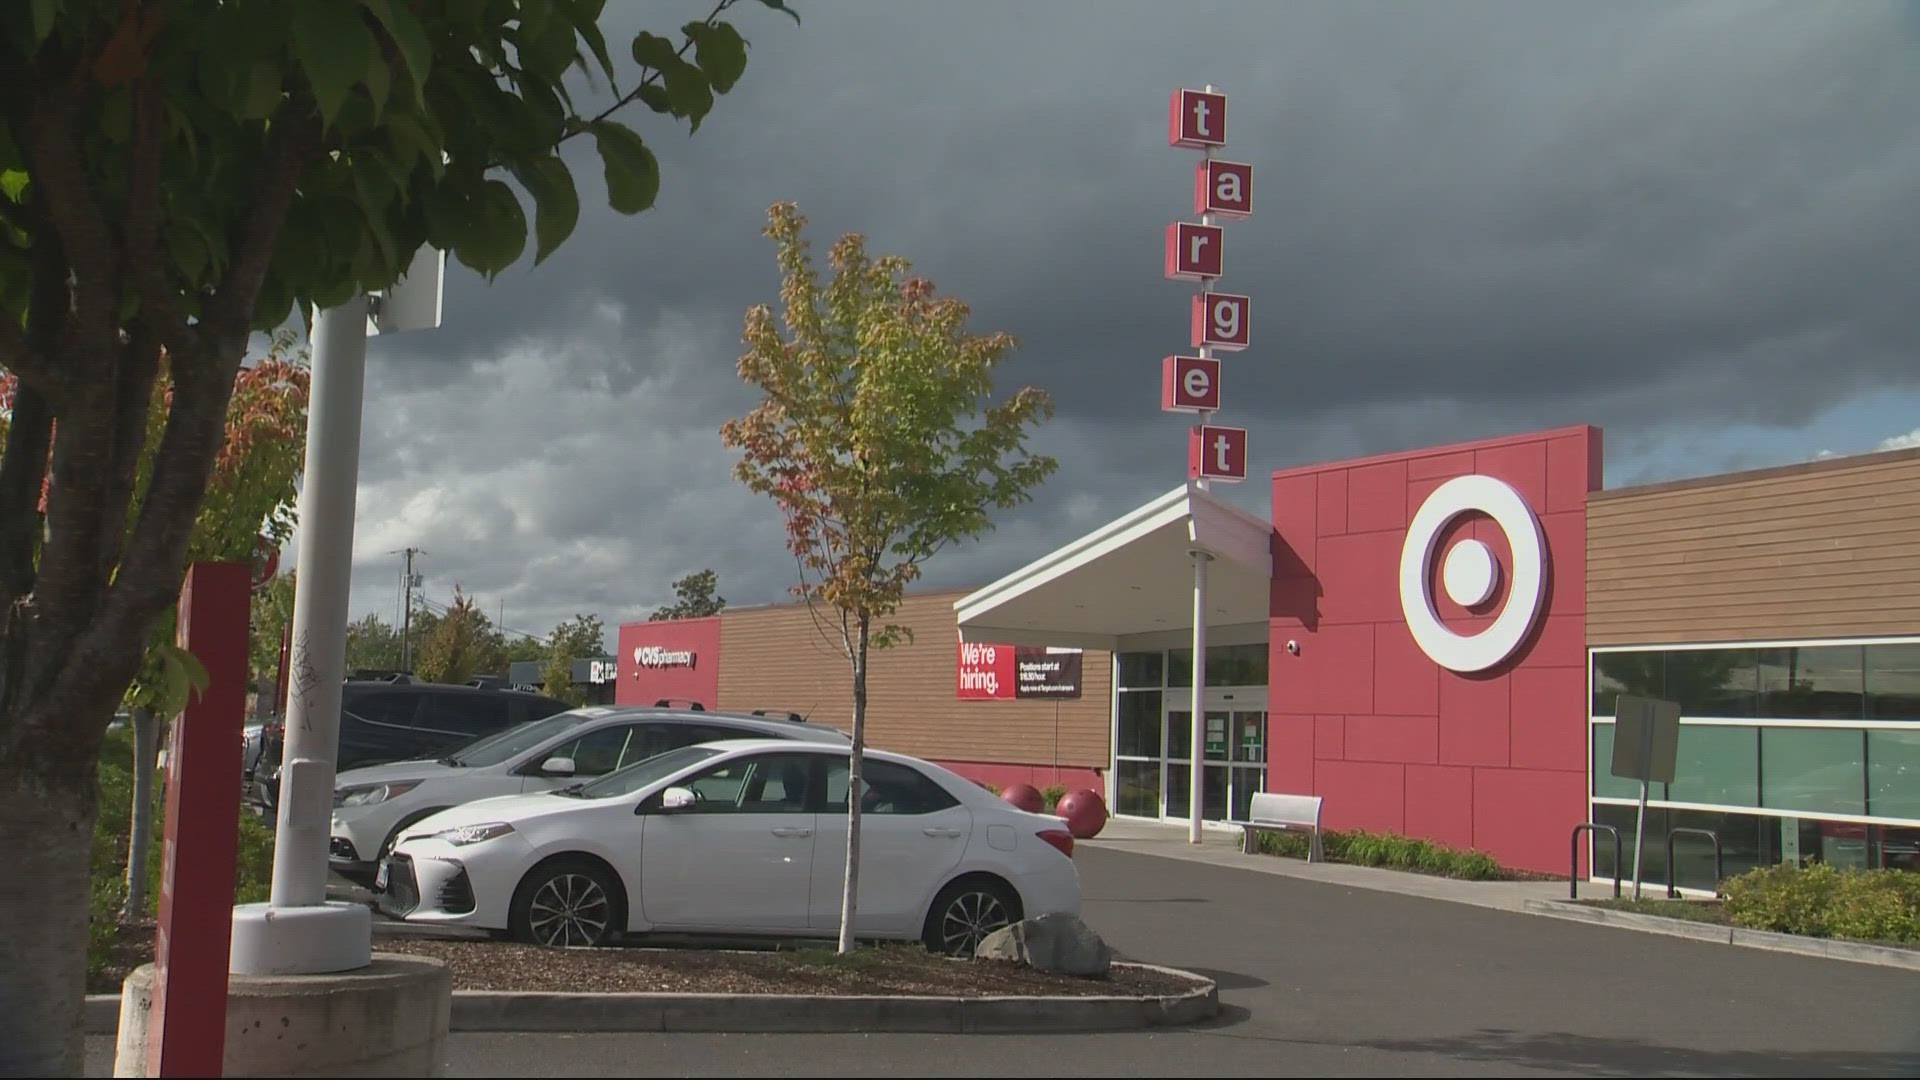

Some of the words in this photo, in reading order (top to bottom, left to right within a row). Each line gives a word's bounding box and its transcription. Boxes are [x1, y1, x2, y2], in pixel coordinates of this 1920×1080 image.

[641, 646, 659, 665] CVS
[659, 648, 691, 667] pharmacy
[961, 643, 996, 665] We're
[1041, 662, 1053, 671] start
[1053, 662, 1060, 671] at
[960, 666, 999, 694] hiring.
